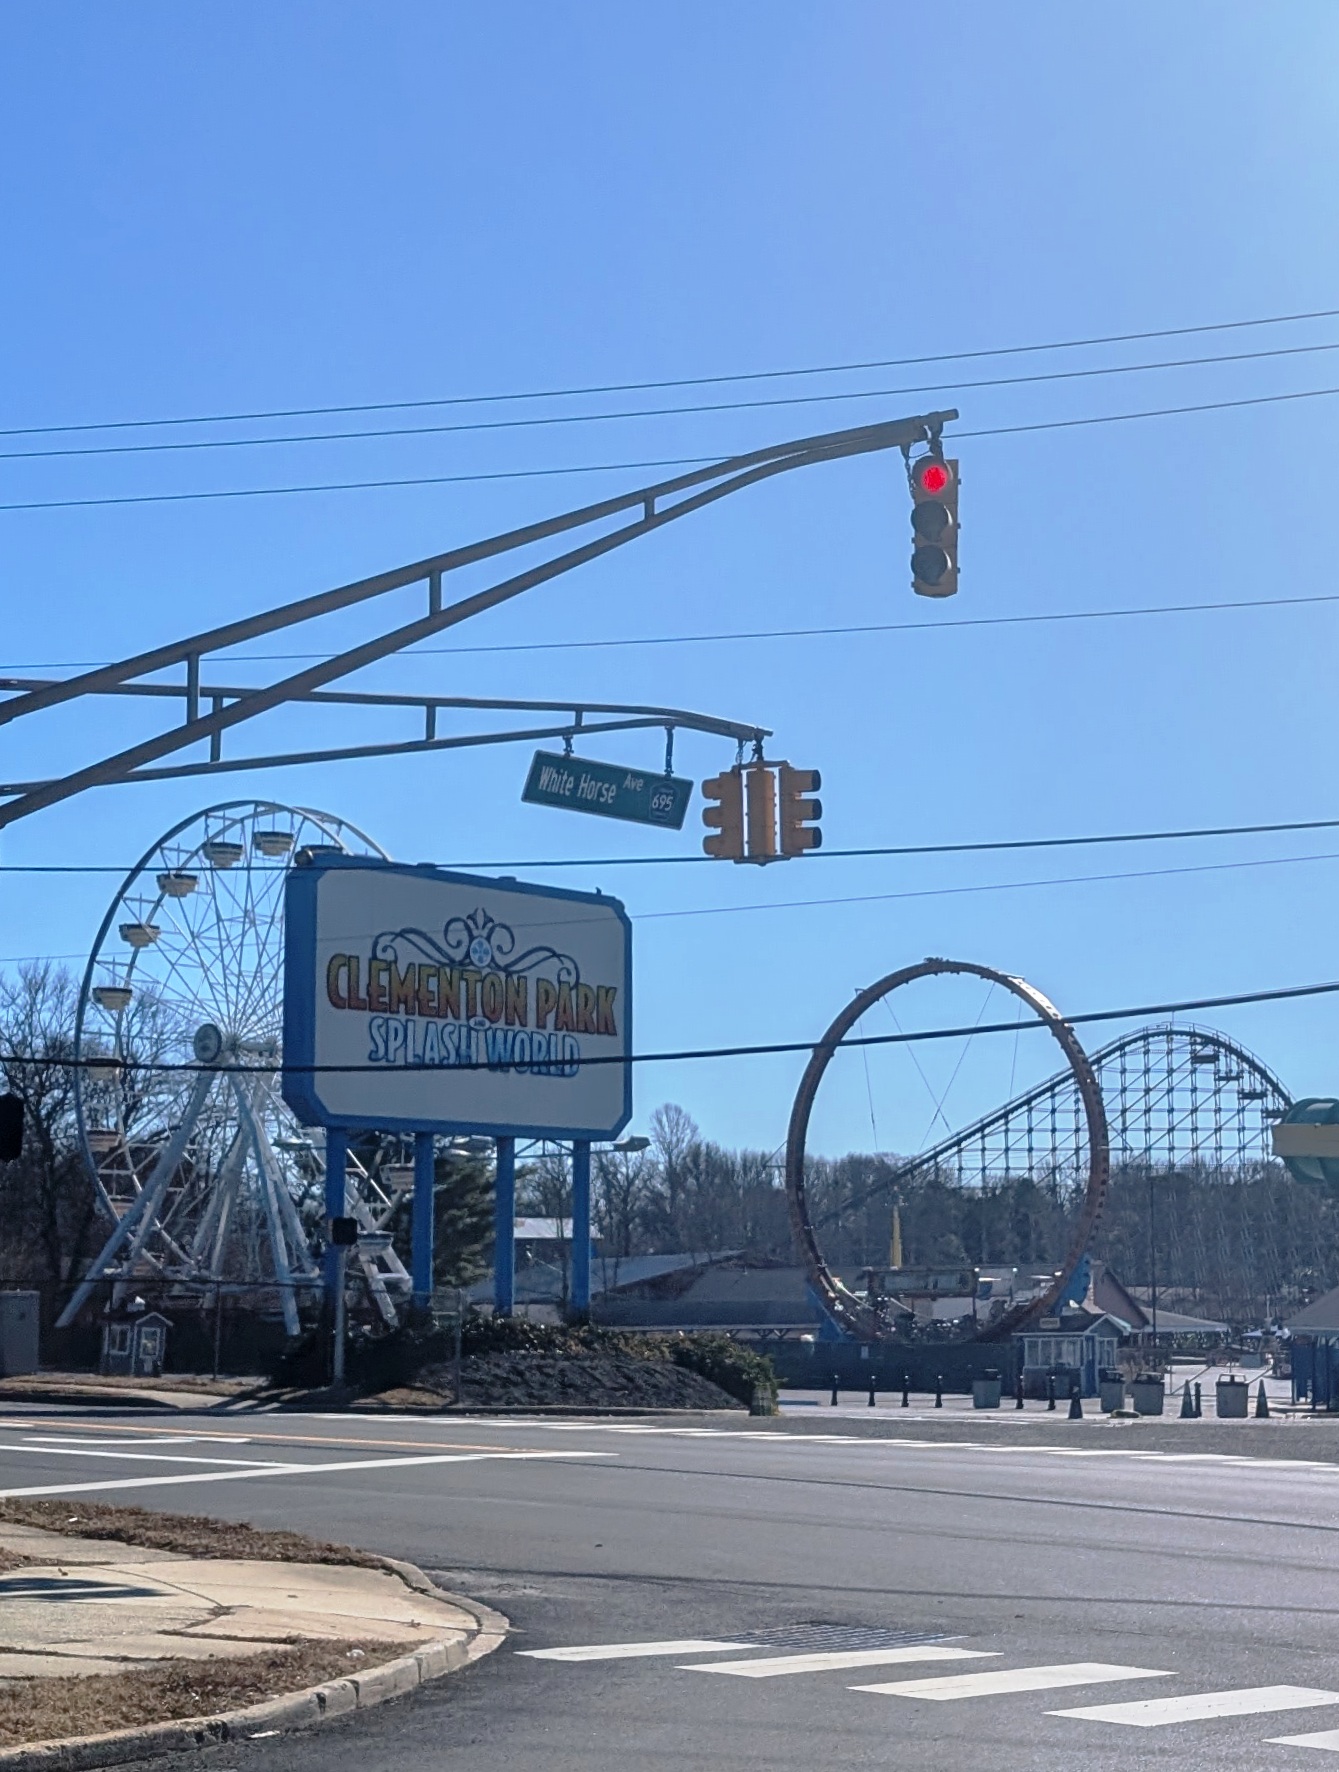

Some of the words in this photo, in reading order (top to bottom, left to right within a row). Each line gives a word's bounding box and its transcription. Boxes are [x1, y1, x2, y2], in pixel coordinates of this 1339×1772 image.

[538, 764, 574, 792] White
[576, 773, 616, 805] Horse
[622, 773, 644, 792] Ave
[651, 792, 673, 811] 695
[326, 953, 528, 1028] CLEMENTON
[536, 978, 618, 1036] PARK
[368, 1016, 483, 1068] SPLASH
[485, 1027, 581, 1078] WORLD
